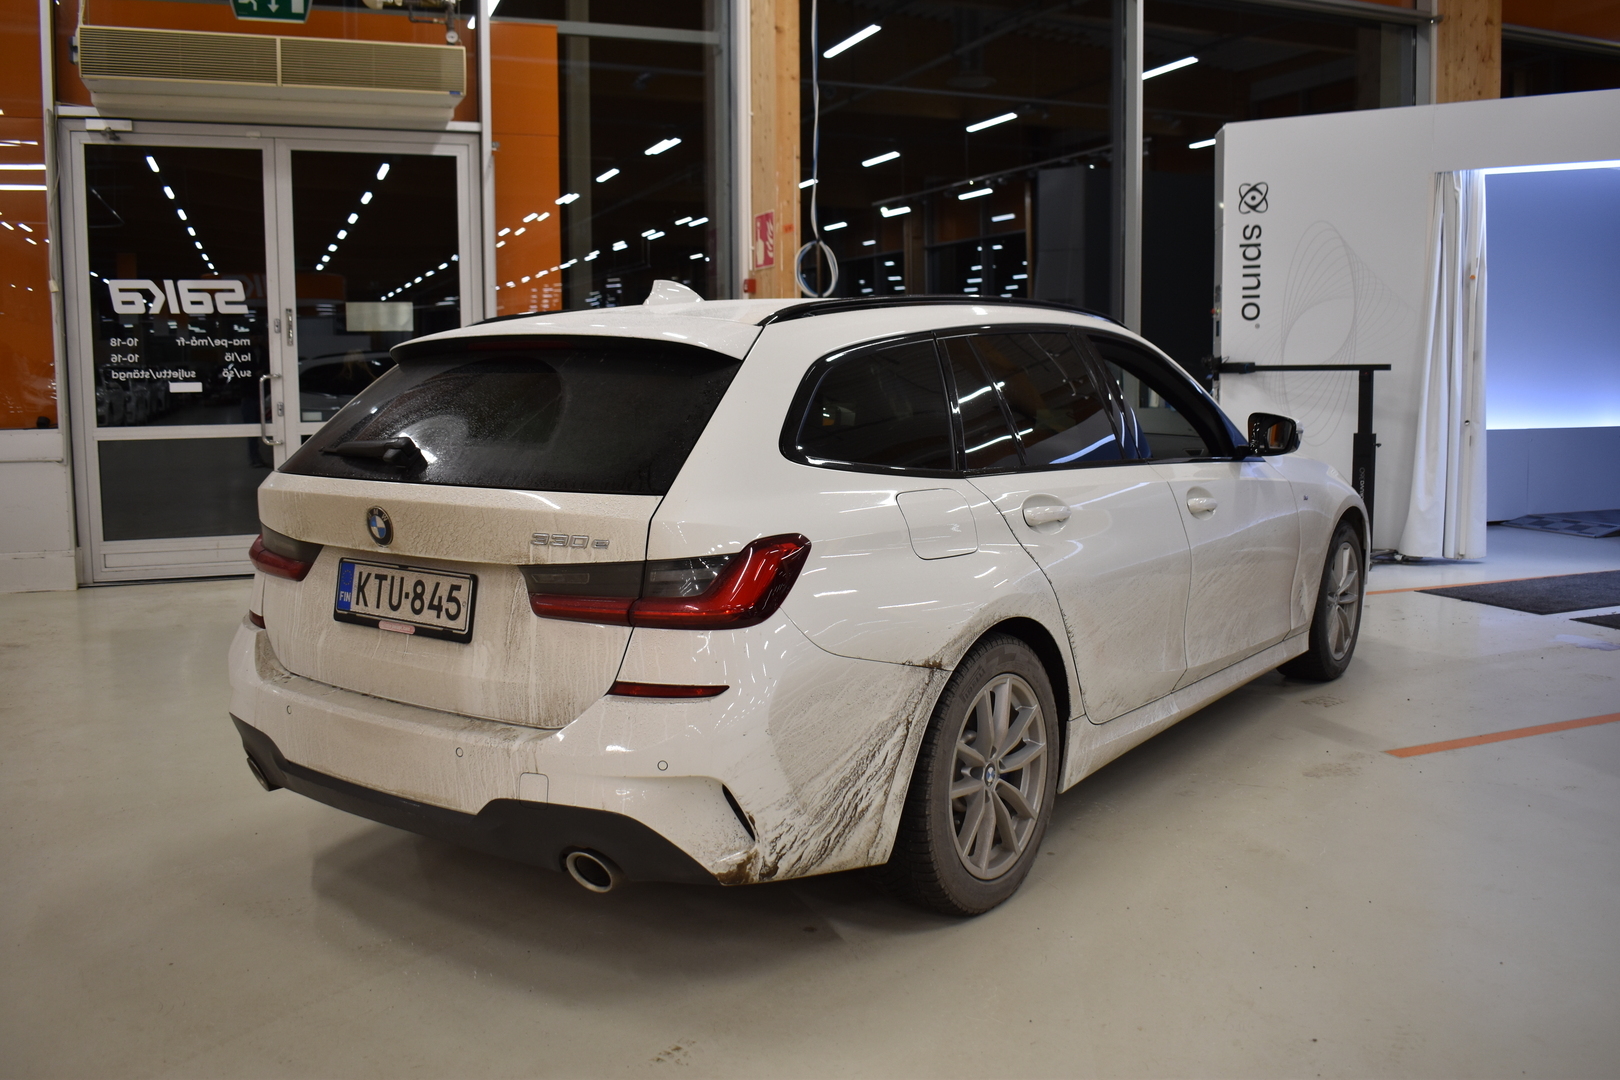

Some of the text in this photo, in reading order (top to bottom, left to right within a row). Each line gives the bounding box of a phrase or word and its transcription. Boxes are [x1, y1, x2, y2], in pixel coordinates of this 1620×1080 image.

[1239, 224, 1262, 321] spinio
[339, 591, 351, 602] FIN
[355, 571, 462, 621] KTU-845
